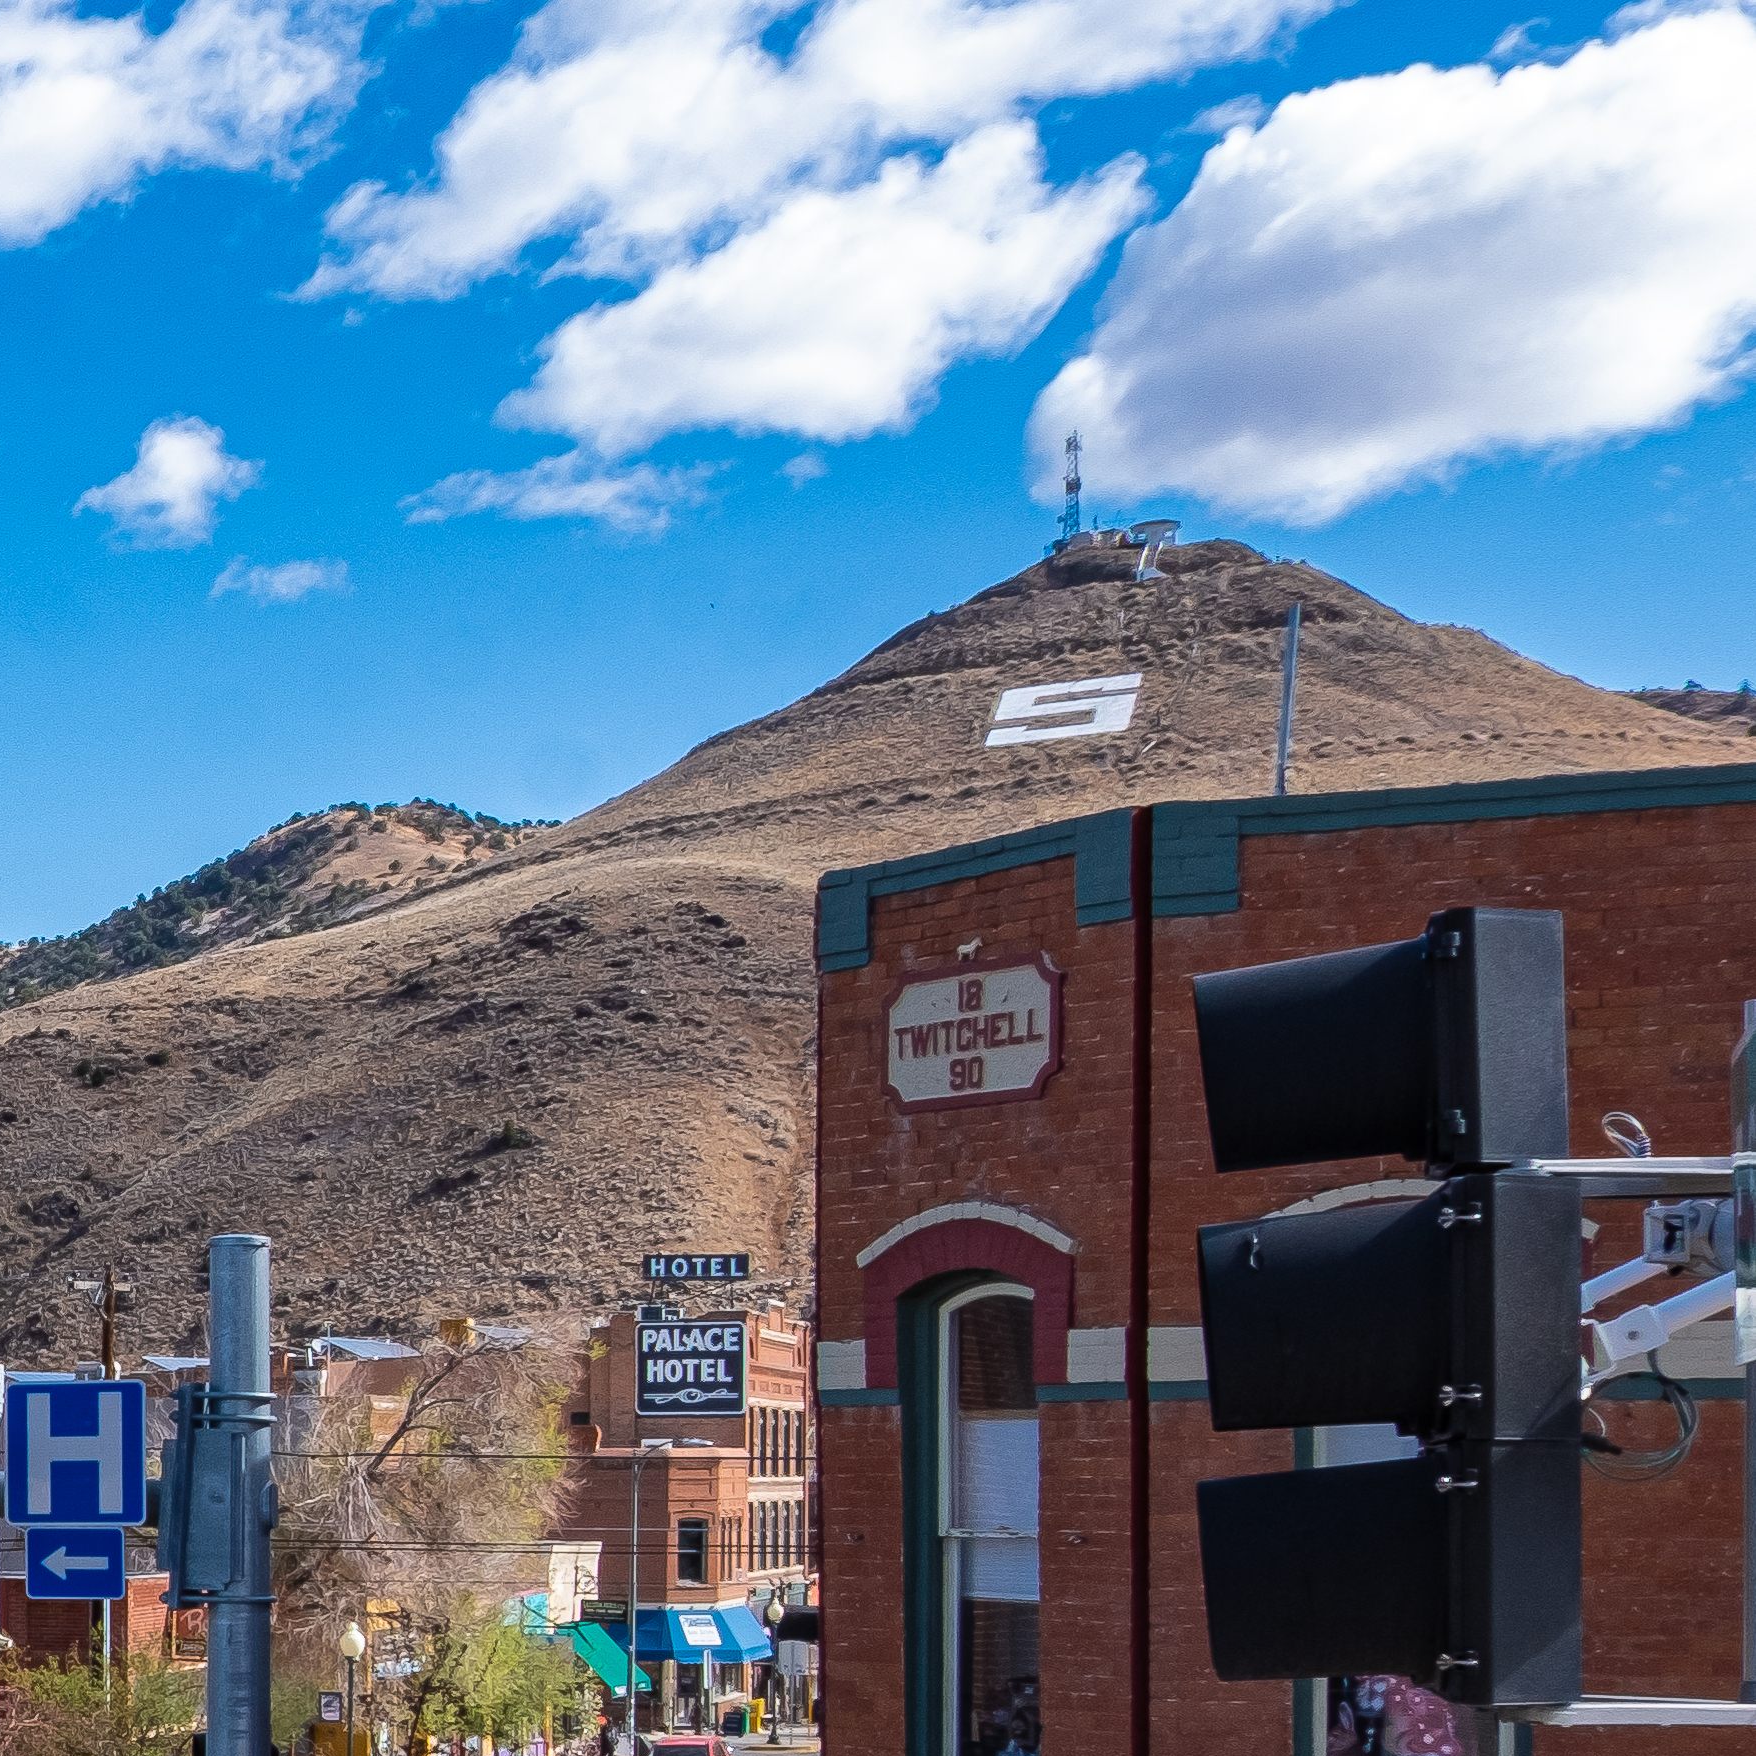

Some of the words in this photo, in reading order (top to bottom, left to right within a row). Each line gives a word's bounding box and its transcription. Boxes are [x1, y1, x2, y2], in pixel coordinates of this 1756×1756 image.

[984, 672, 1143, 747] S
[957, 979, 983, 1012] 18
[894, 1009, 1044, 1060] TWITCHELL
[949, 1056, 983, 1090] 90
[650, 1257, 744, 1277] HOTEL
[642, 1327, 741, 1352] PALACE
[646, 1358, 733, 1383] HOTEL
[27, 1392, 124, 1516] H
